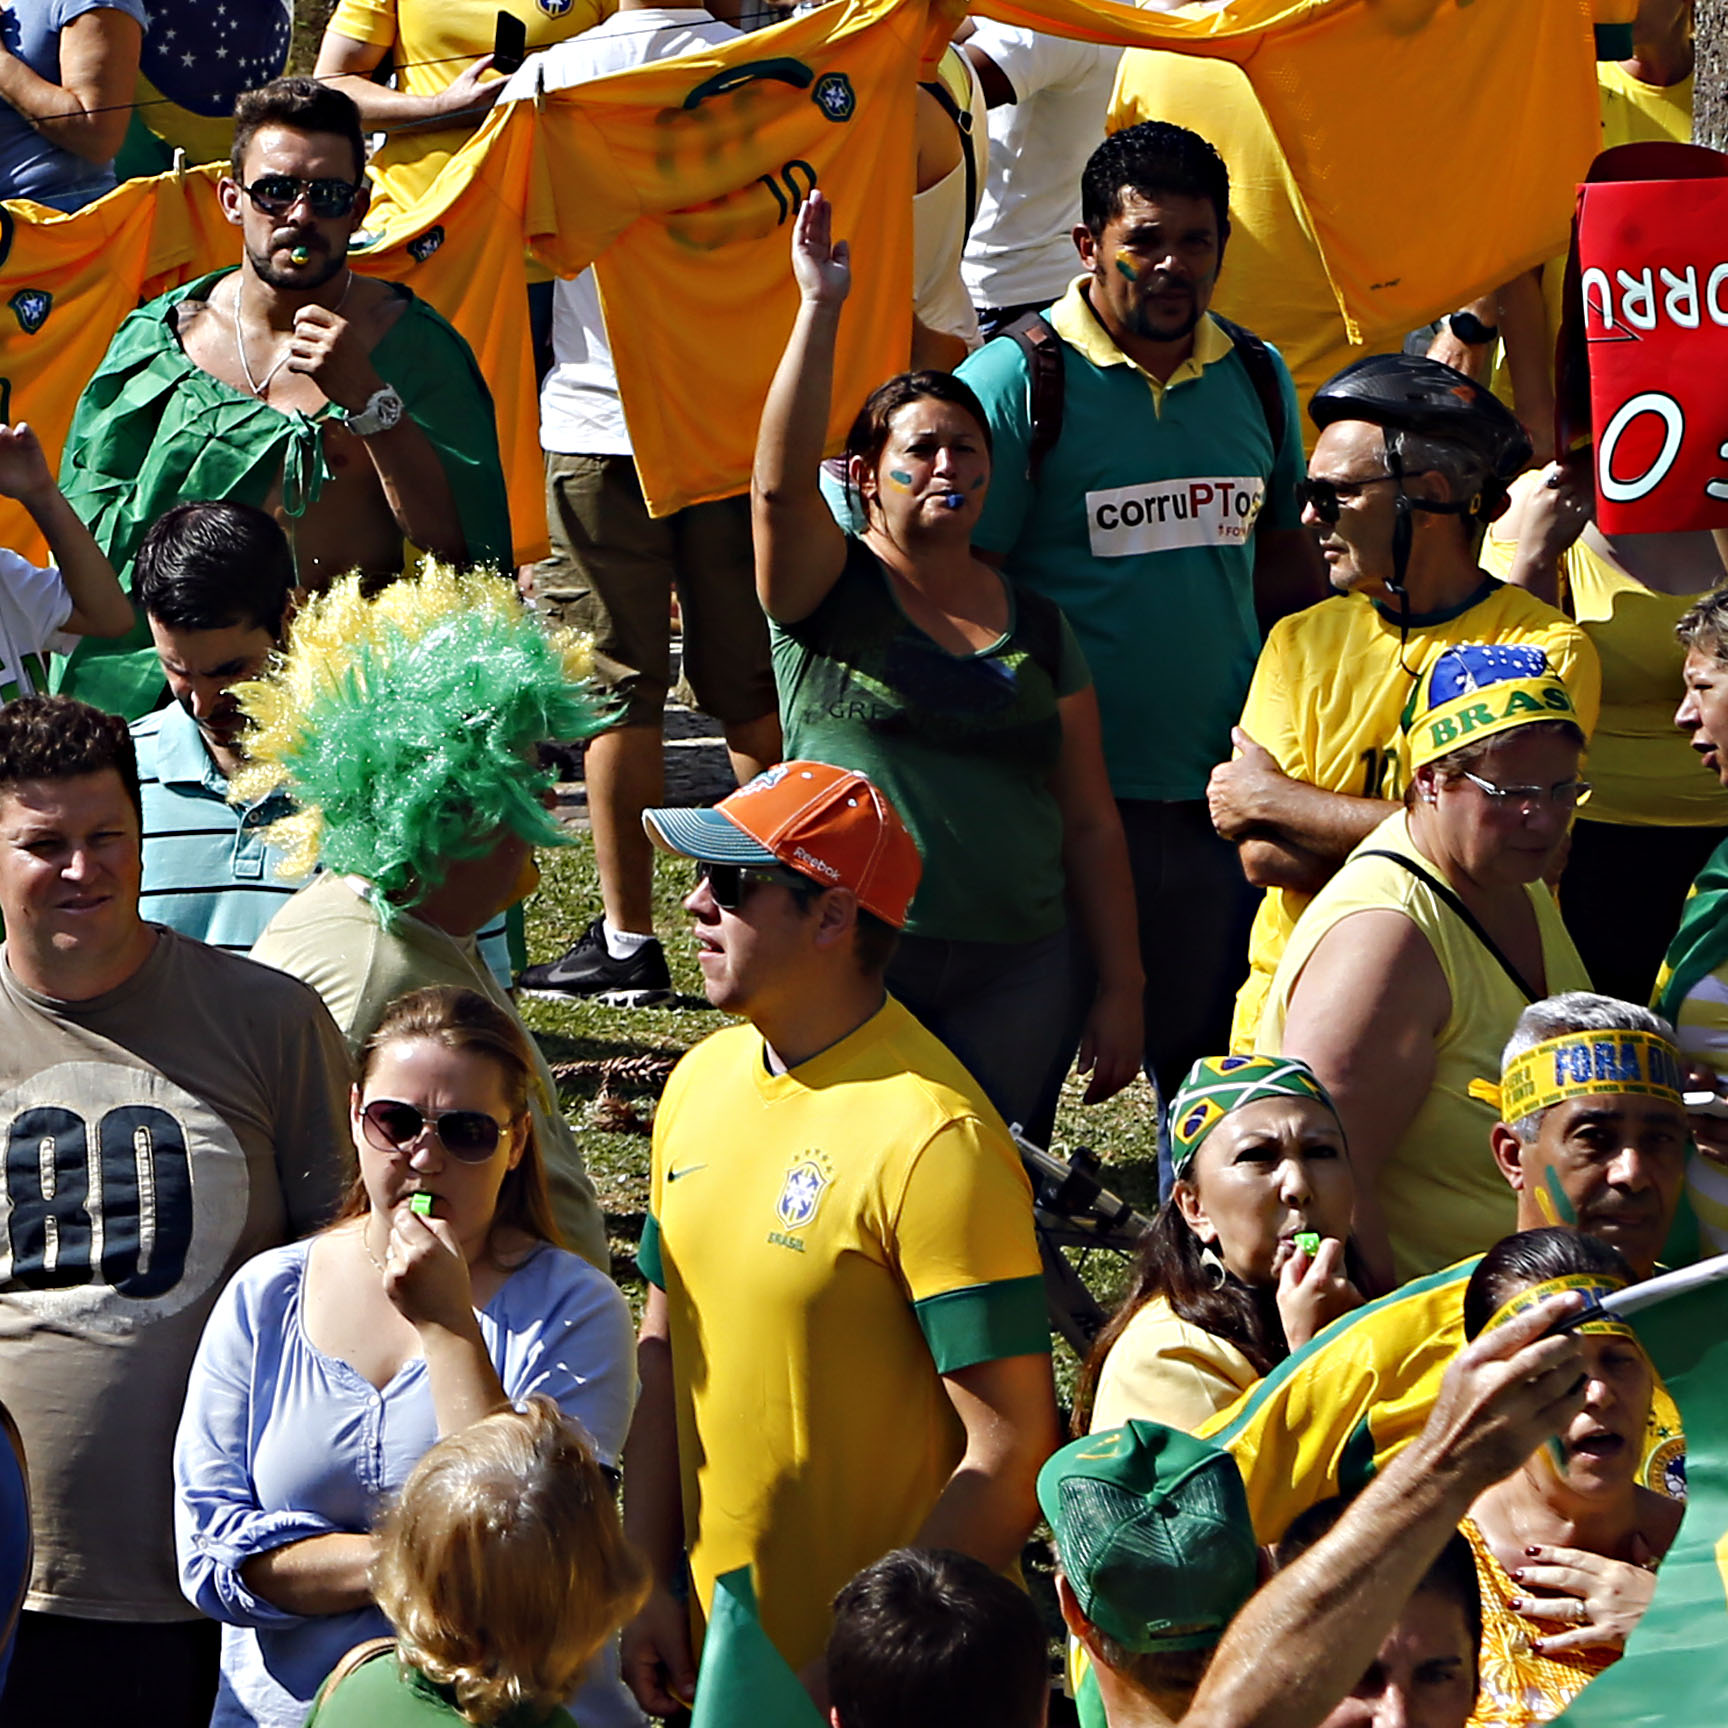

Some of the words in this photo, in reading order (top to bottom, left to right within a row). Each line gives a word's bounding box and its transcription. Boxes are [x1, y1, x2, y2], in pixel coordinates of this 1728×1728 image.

[793, 846, 842, 881] Reebok
[1555, 1041, 1643, 1087] FORA
[6, 1104, 194, 1301] 80
